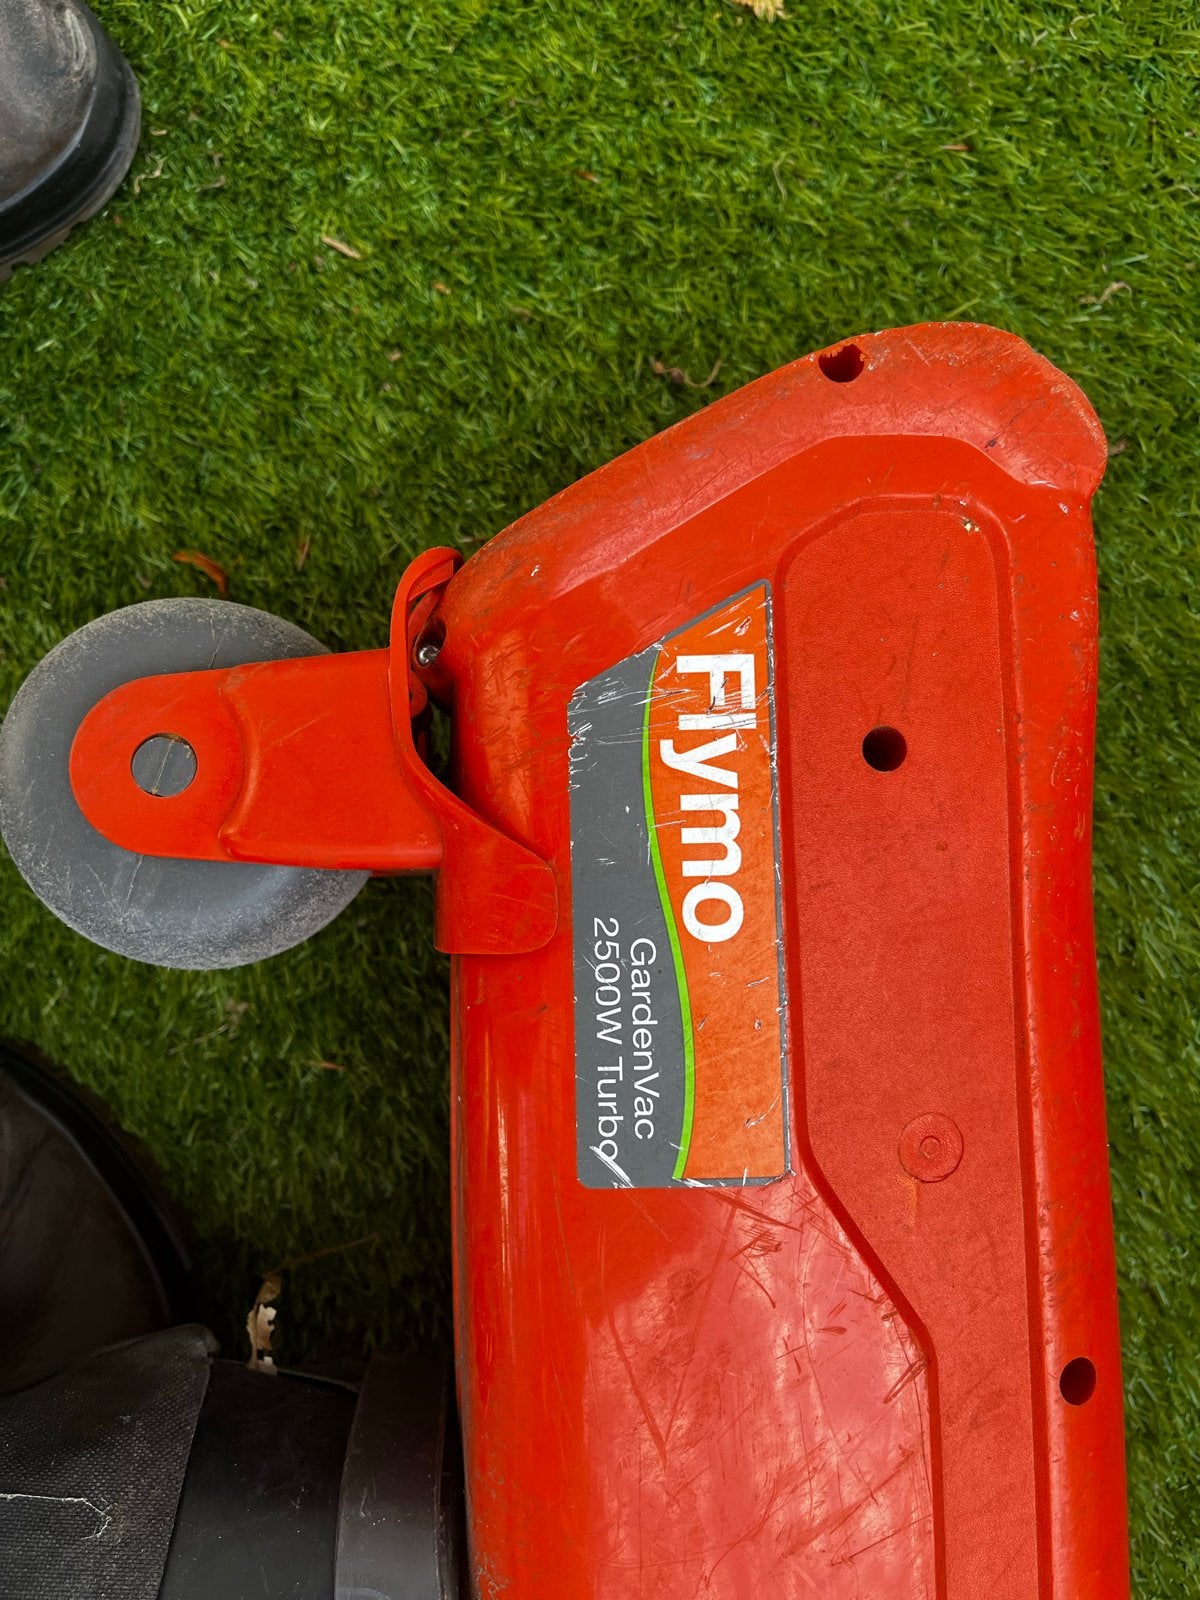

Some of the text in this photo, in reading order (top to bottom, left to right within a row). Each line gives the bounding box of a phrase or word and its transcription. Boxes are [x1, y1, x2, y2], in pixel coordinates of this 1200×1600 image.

[660, 653, 757, 943] Flymo
[594, 917, 624, 1160] 2500W Turbo
[630, 938, 660, 1140] GardenVac
